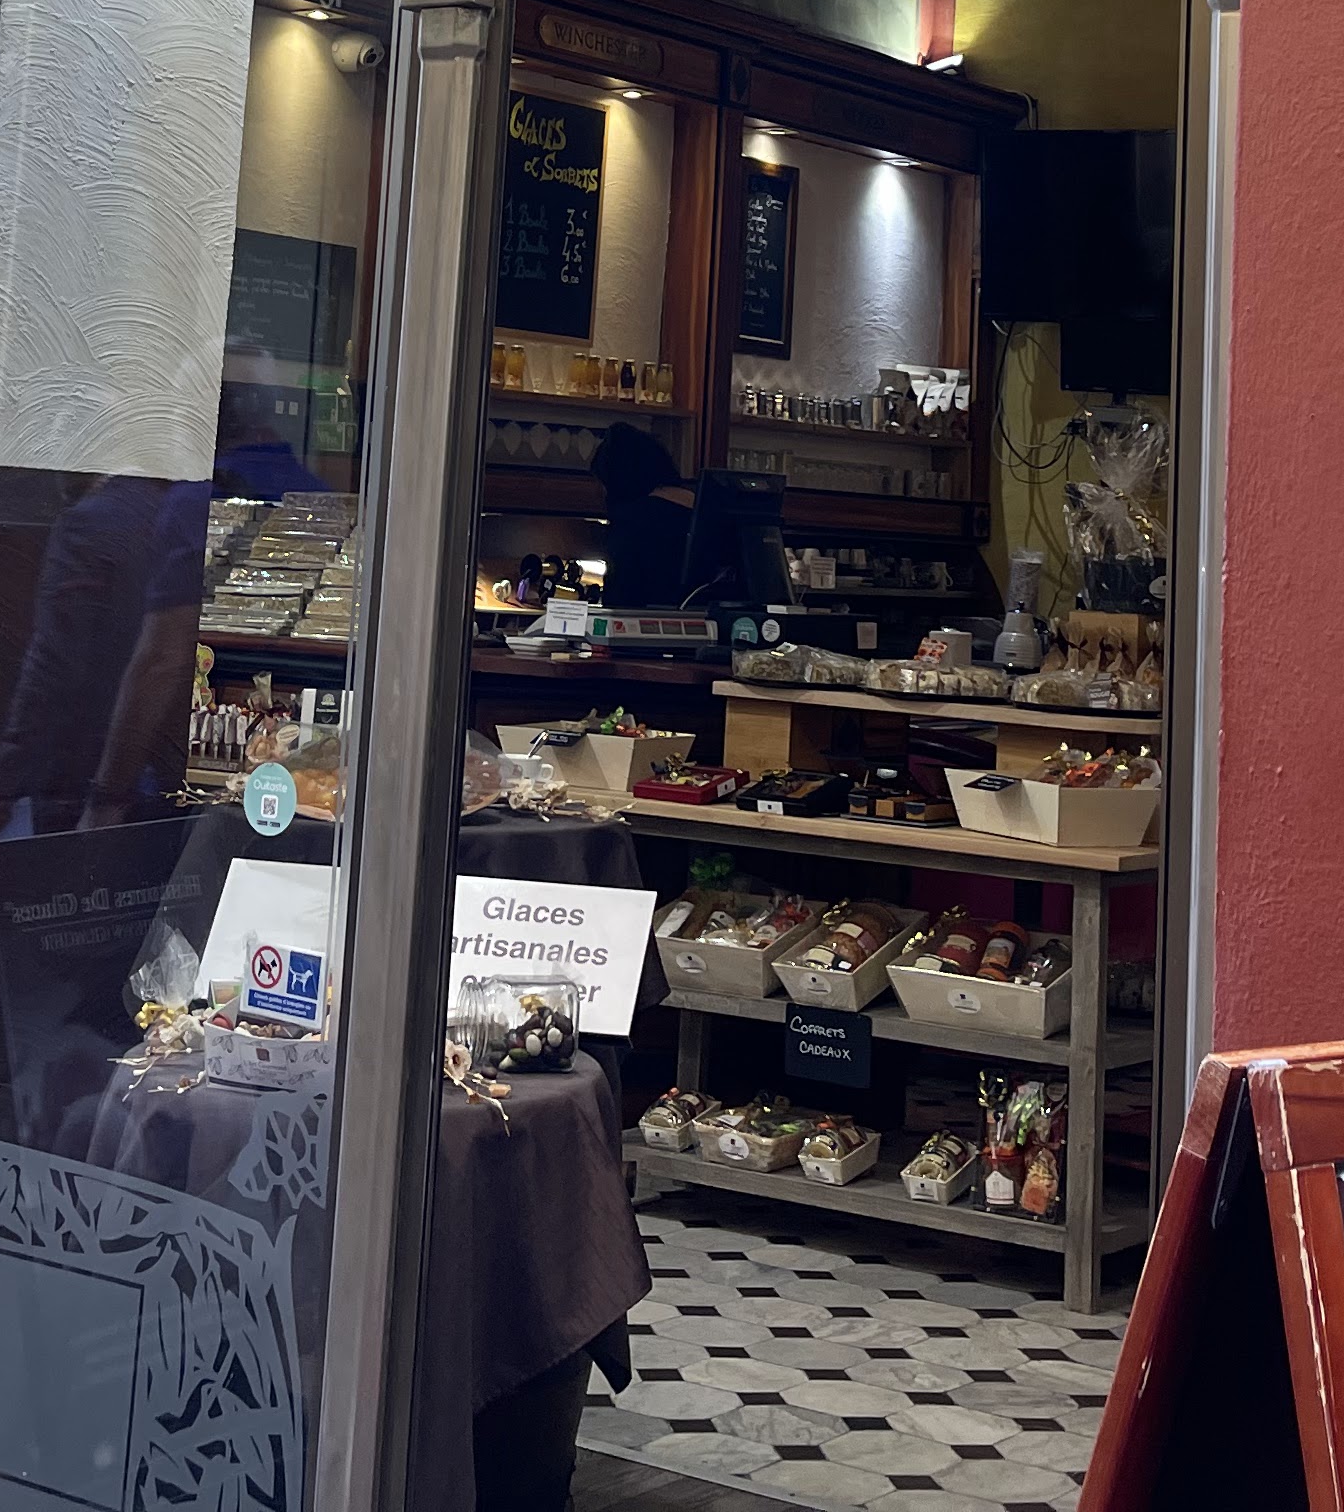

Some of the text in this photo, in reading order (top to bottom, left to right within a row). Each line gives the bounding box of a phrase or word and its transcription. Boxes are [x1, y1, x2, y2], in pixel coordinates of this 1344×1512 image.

[482, 895, 585, 926] Glaces
[789, 1015, 846, 1039] COFFRETS
[799, 1040, 852, 1061] CADEAUX
